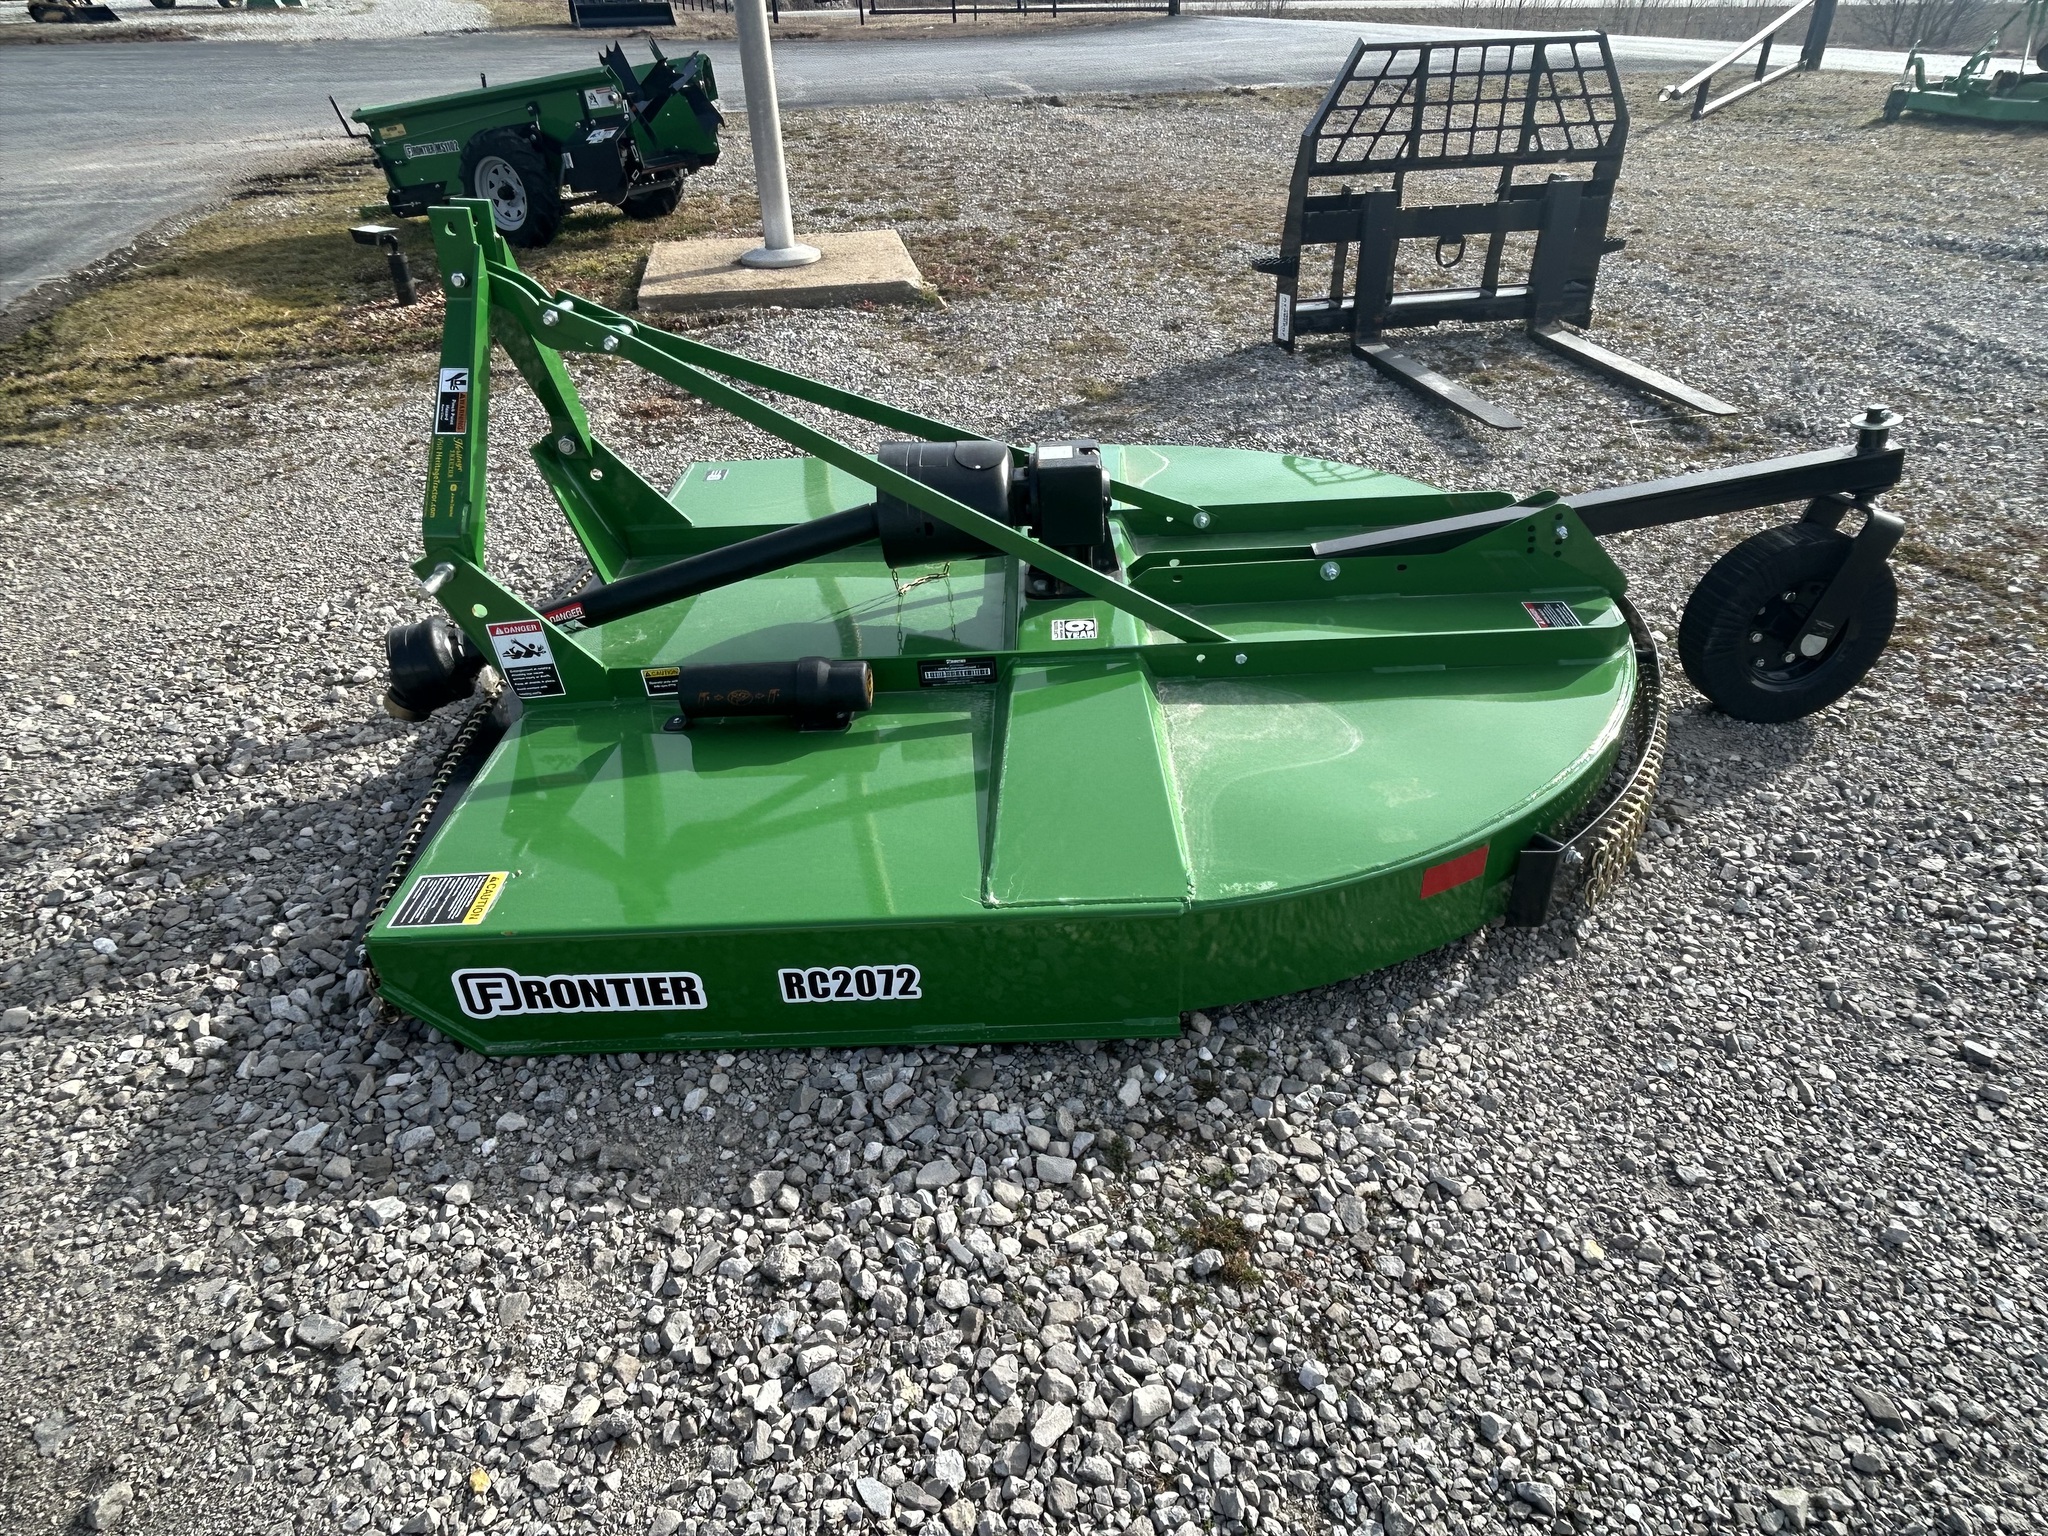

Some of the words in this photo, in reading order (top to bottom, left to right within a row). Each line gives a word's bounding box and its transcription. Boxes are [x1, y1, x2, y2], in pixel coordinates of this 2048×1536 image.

[453, 437, 463, 472] Heritage
[430, 452, 443, 518] HeritageTractor.com
[549, 606, 583, 623] DANGER
[504, 624, 537, 635] DANGER
[1065, 630, 1095, 639] YEAR
[651, 669, 679, 677] CAUTION
[468, 883, 497, 920] CAUTION
[456, 971, 702, 1017] FRONTIER
[781, 967, 919, 1001] RC2072
